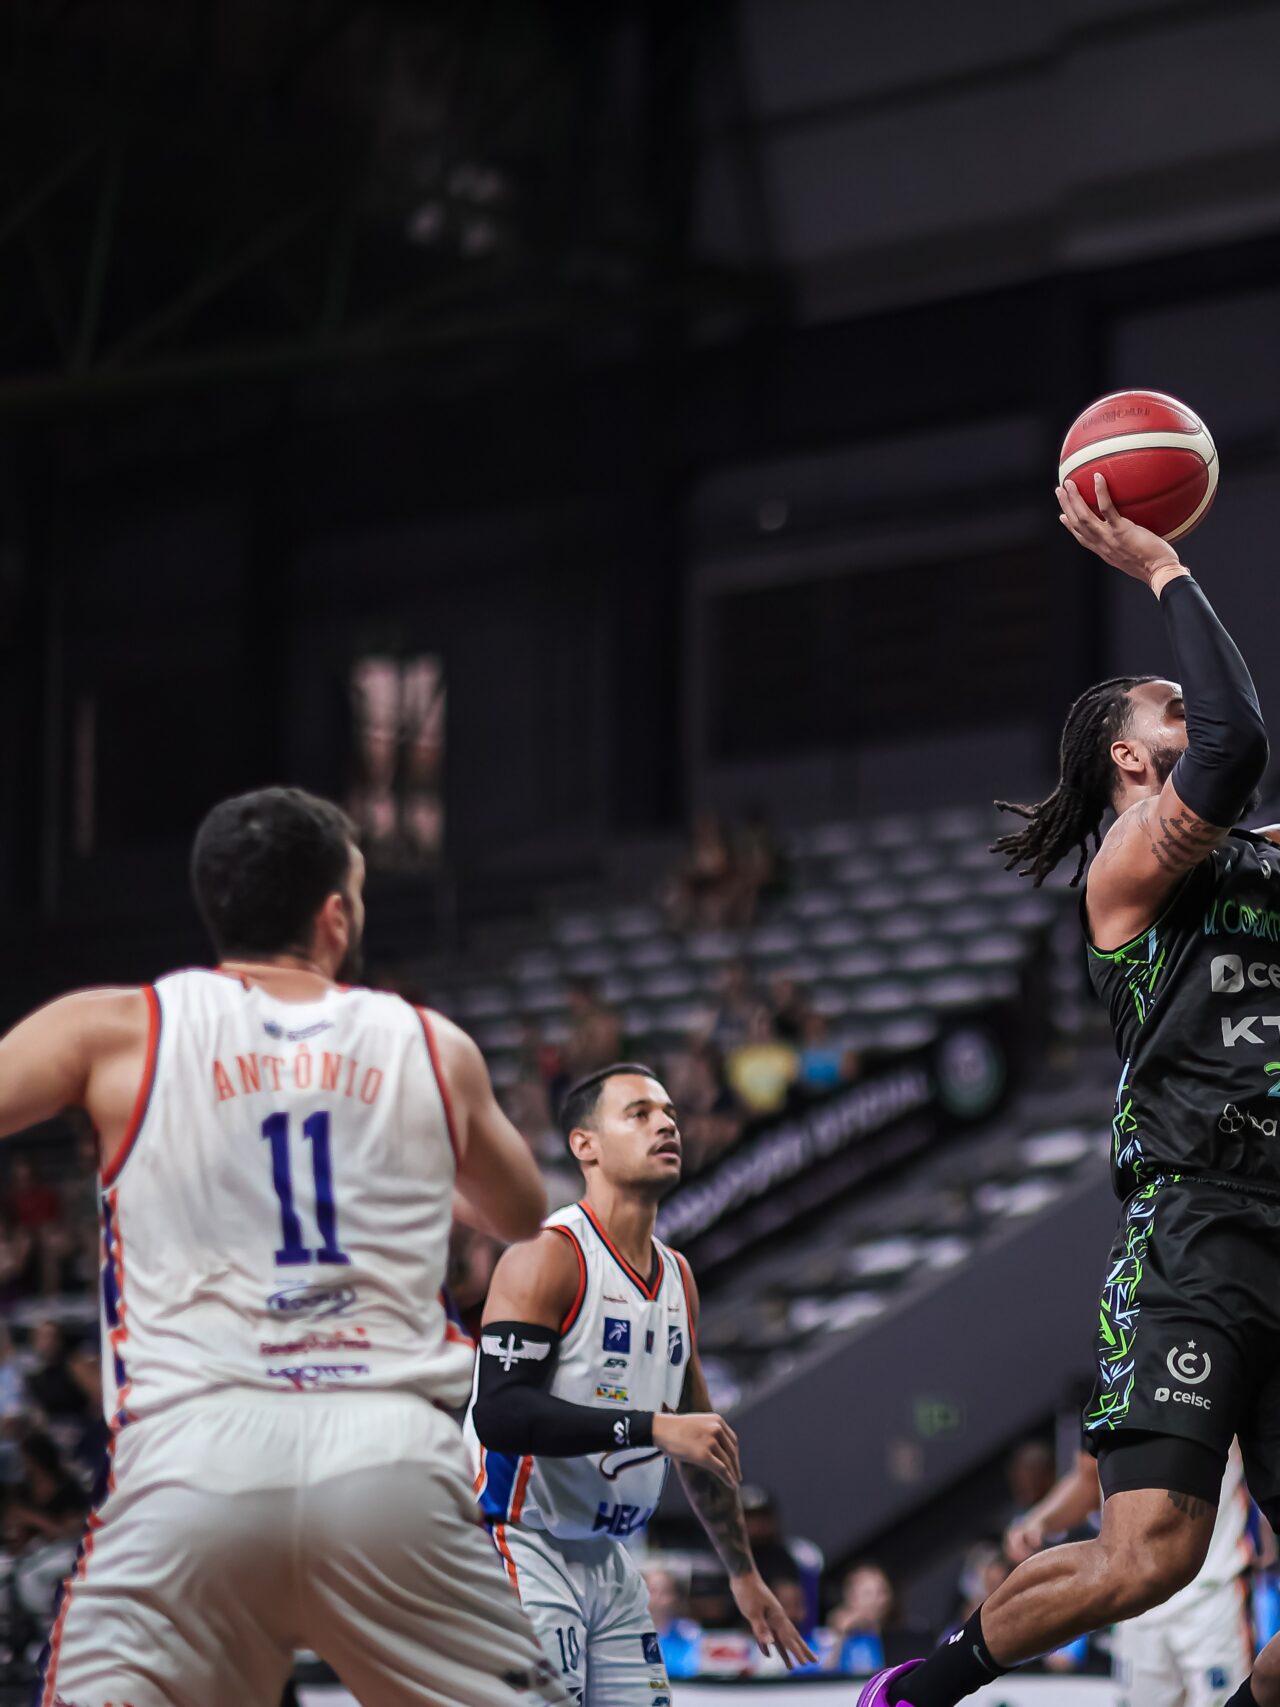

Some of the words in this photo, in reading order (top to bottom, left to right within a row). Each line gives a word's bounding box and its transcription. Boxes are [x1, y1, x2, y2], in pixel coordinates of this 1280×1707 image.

[213, 1043, 384, 1105] ANTÔNIO
[261, 1110, 351, 1266] 11
[1173, 1388, 1212, 1410] ceisc
